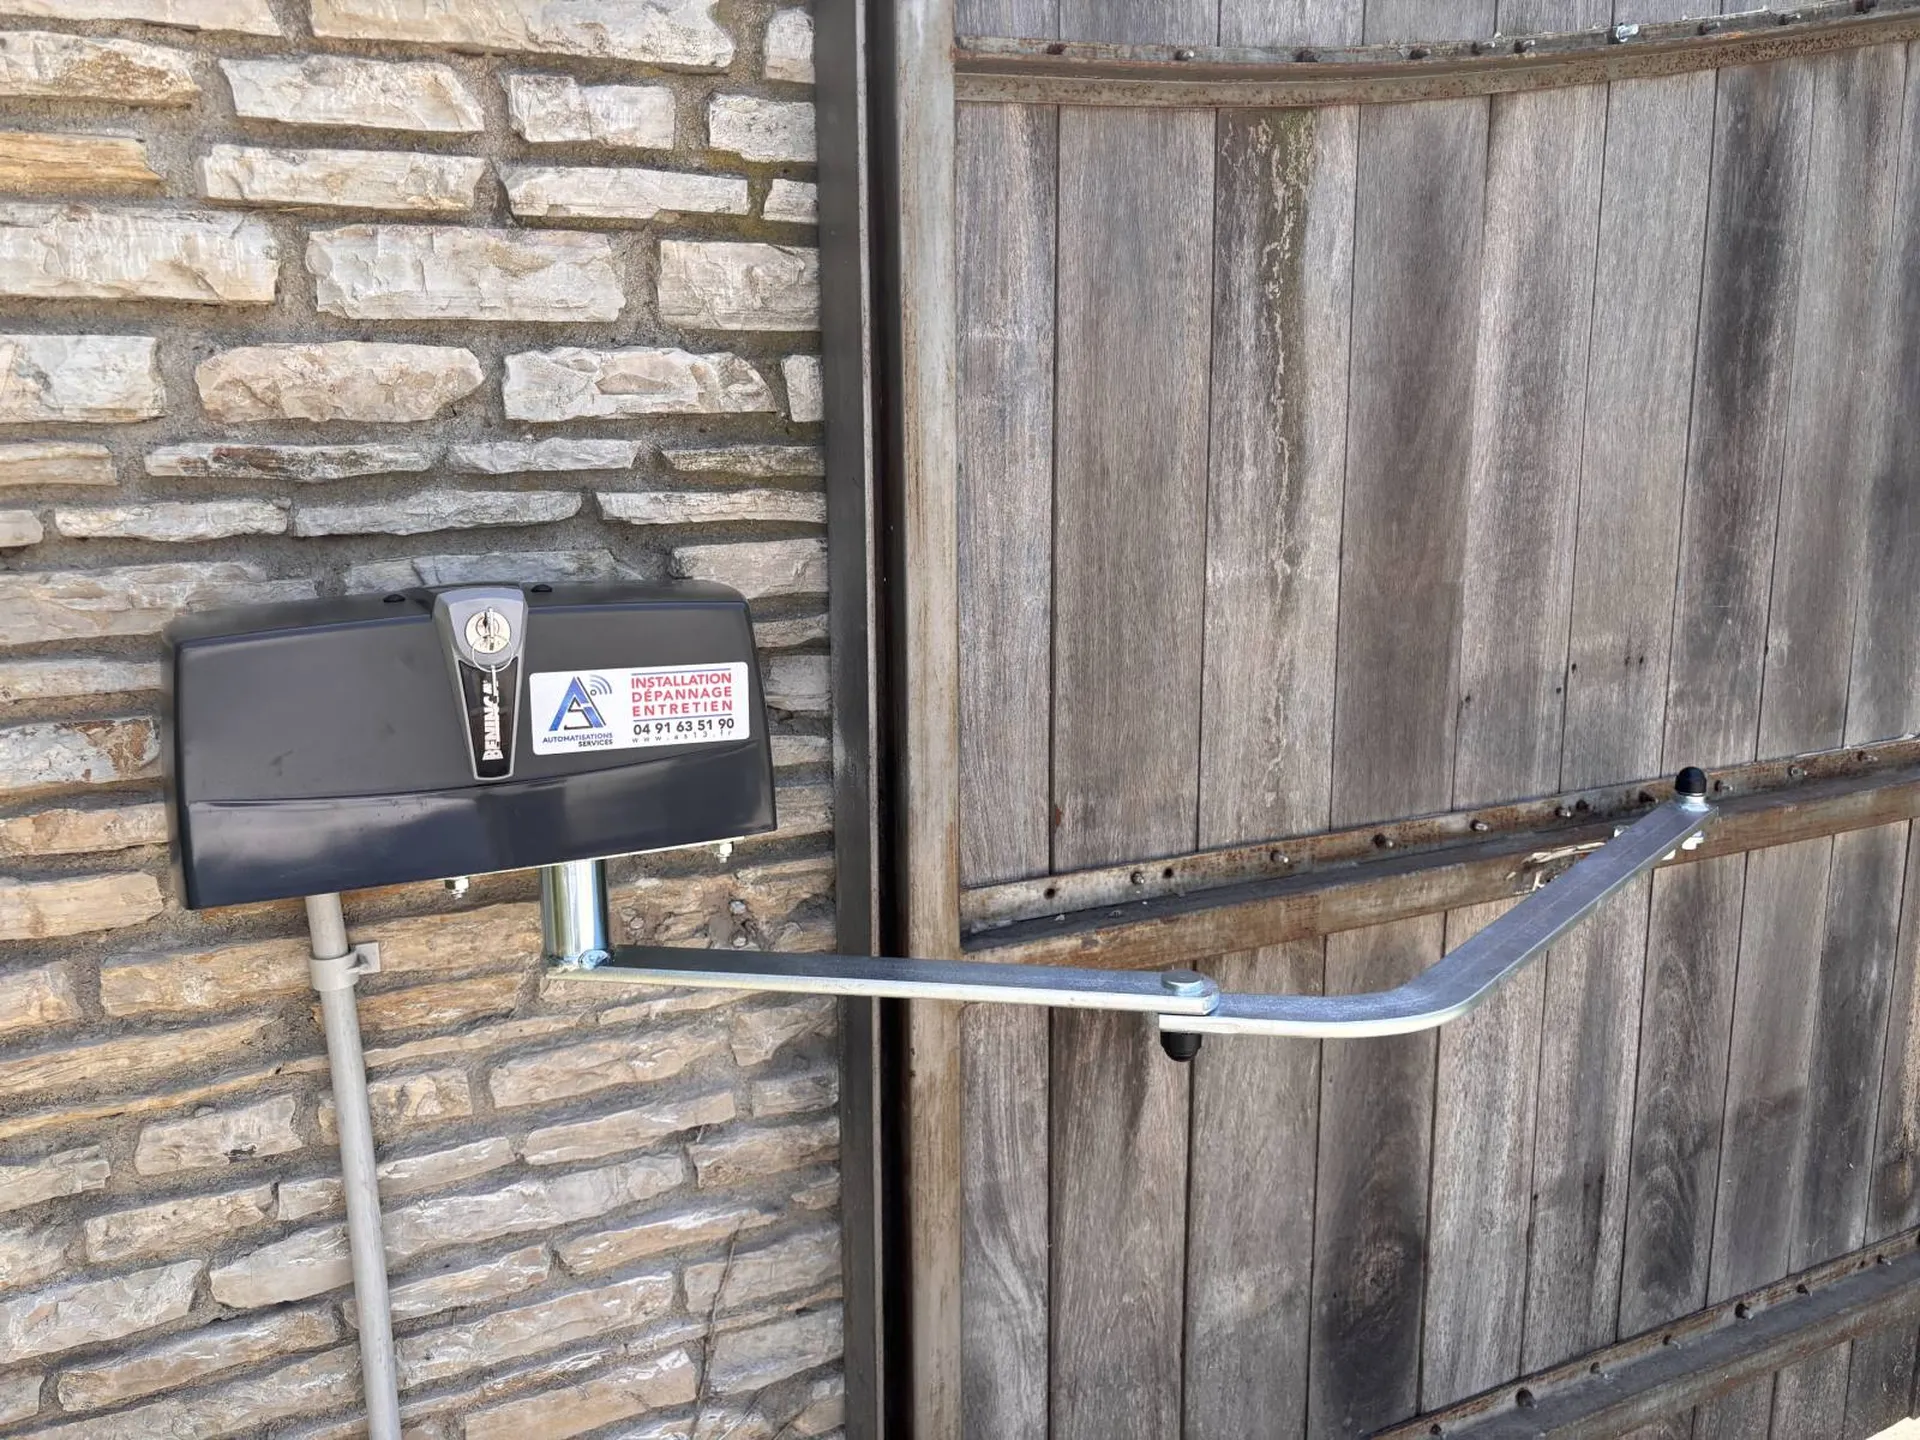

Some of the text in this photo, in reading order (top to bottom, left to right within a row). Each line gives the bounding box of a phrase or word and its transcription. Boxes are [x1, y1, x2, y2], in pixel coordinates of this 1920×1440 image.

[631, 673, 732, 689] INSTALLATION
[632, 686, 732, 703] DÉPANNAGE
[633, 700, 733, 717] ENTRETIEN
[633, 717, 734, 736] 04 91 63 51 90
[542, 732, 613, 744] AUTOMATISATIONS
[578, 738, 613, 748] SERVICES
